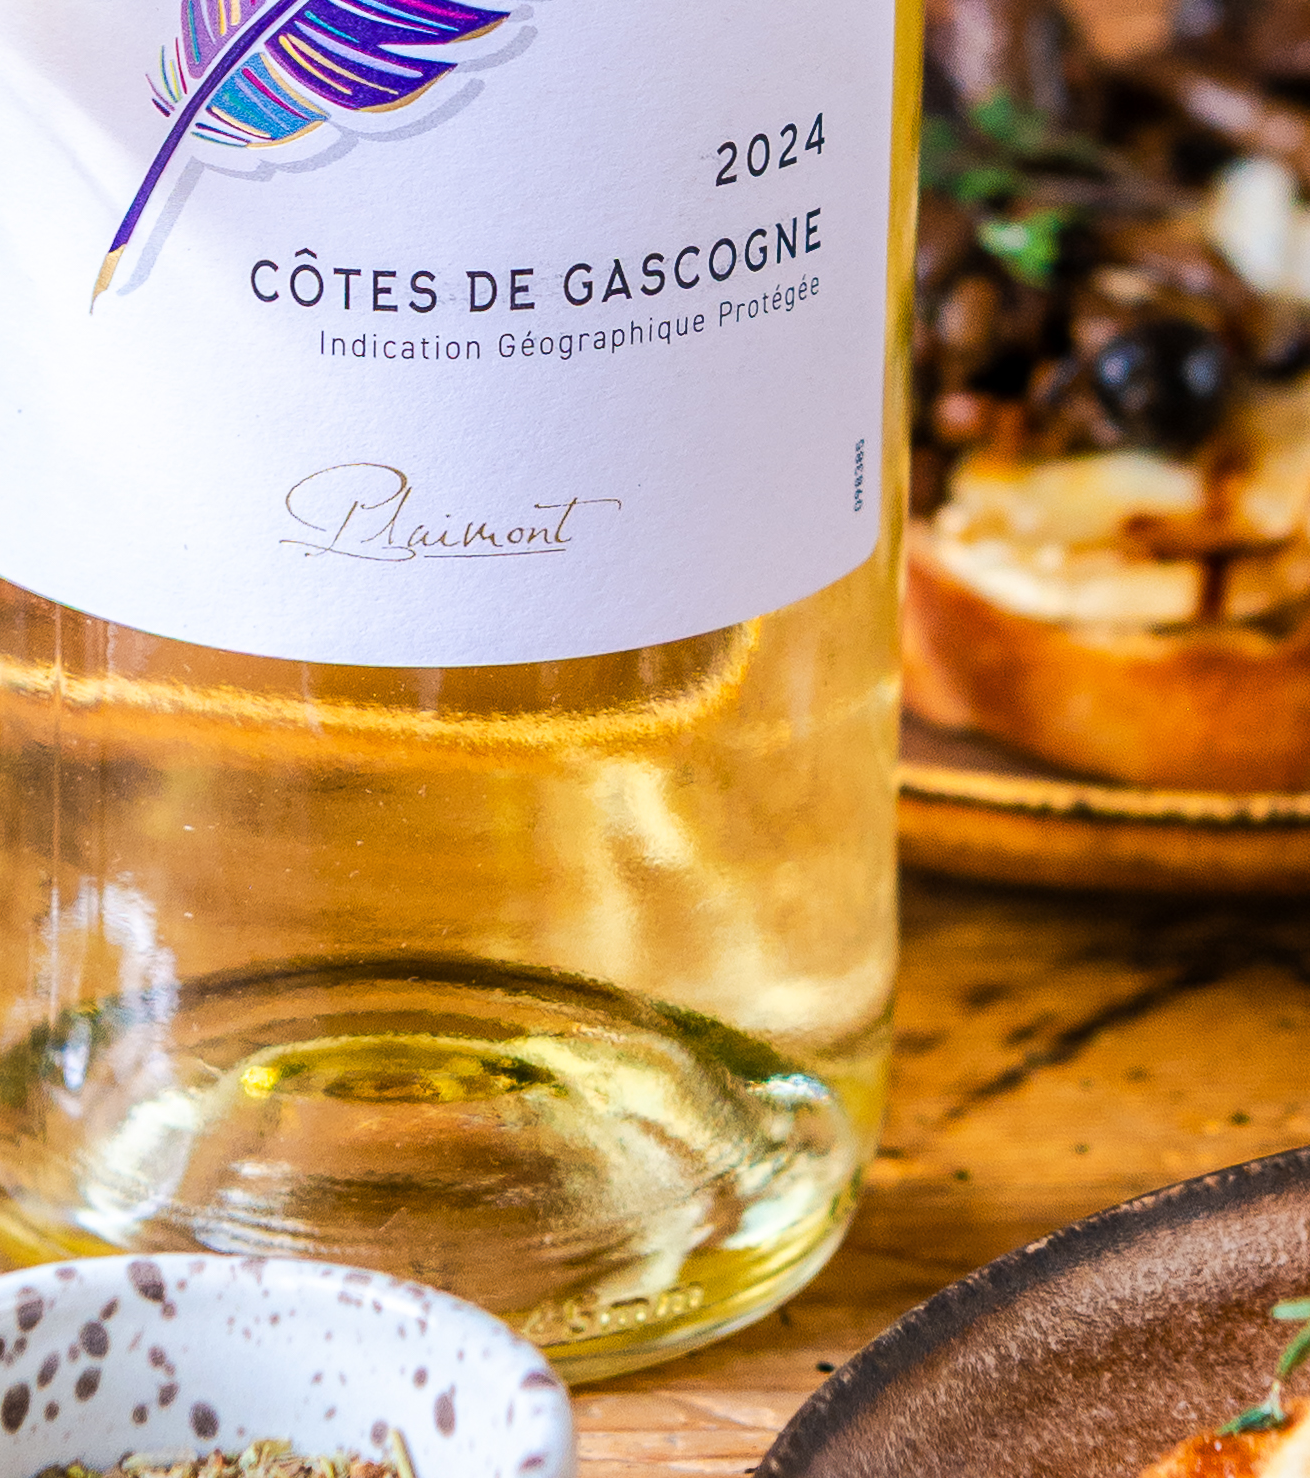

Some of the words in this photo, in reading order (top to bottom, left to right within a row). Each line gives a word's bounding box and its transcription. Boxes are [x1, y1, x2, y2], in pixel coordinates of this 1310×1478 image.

[715, 113, 826, 187] 2024
[250, 248, 438, 313] CÔTES
[466, 268, 536, 312] DE
[562, 207, 822, 306] GASCOGNE
[320, 330, 481, 360] Indication
[497, 312, 706, 360] Géographique
[718, 273, 821, 327] Protégée
[279, 462, 622, 563] Plaimont
